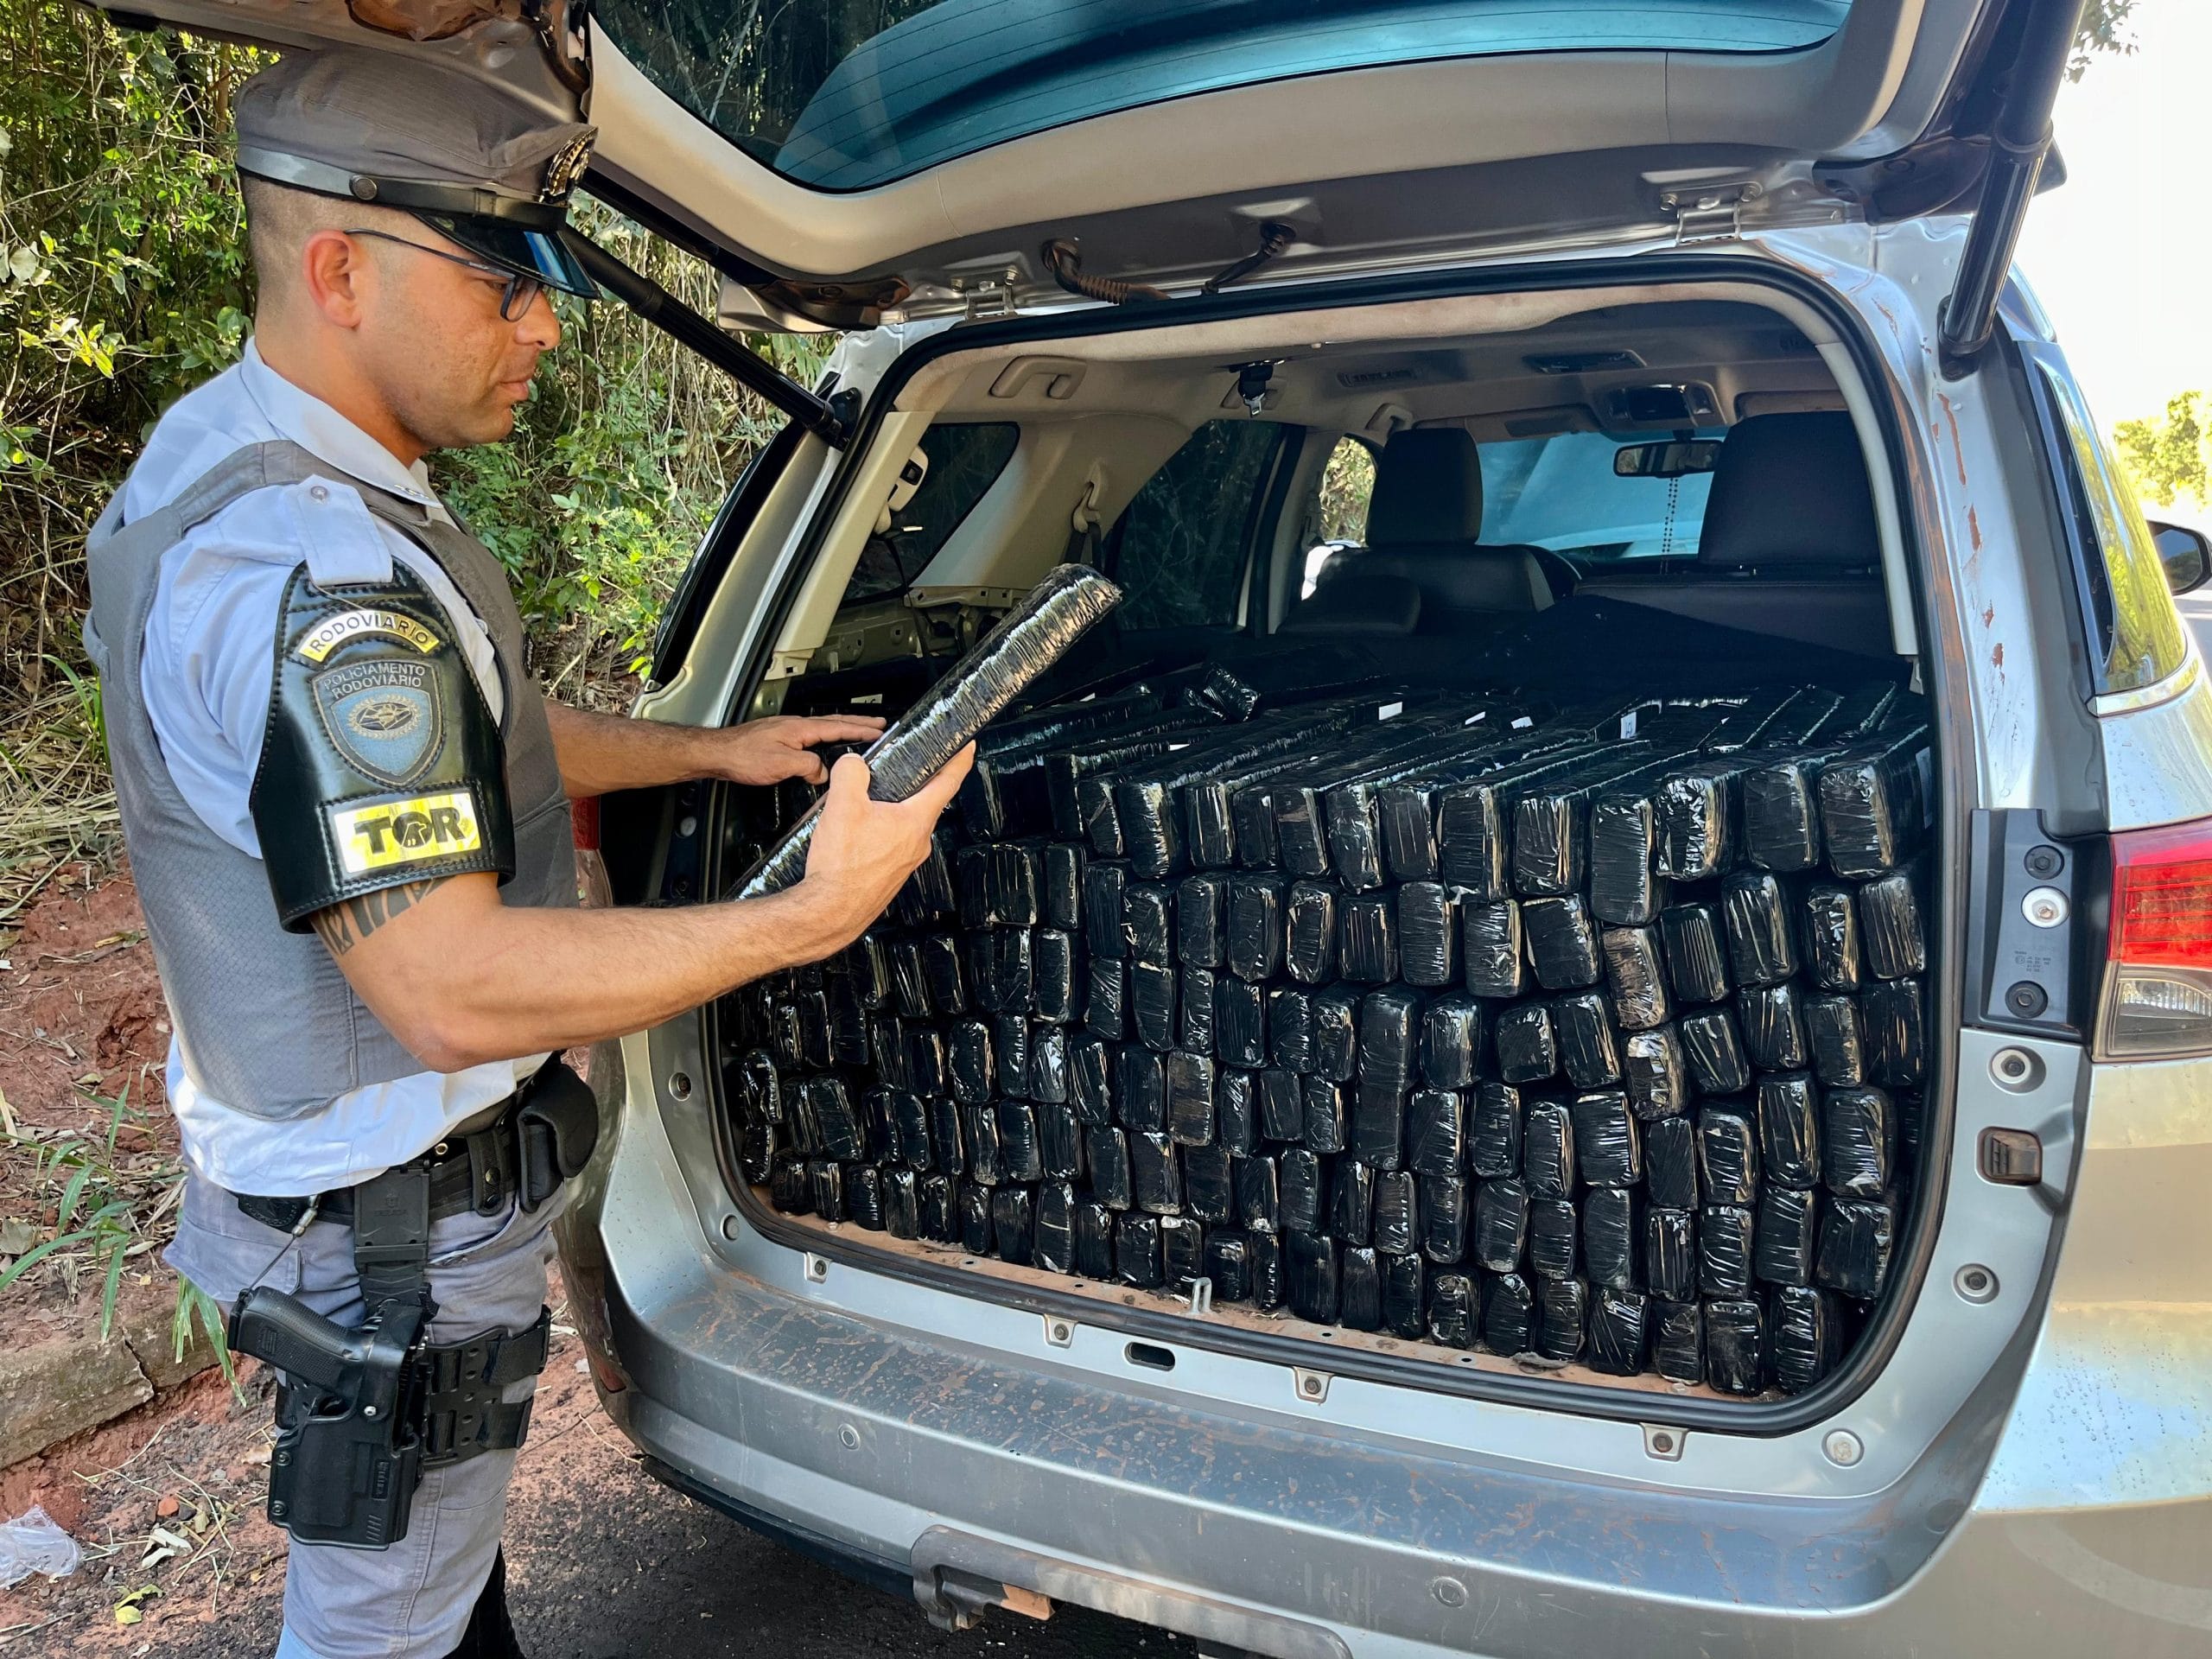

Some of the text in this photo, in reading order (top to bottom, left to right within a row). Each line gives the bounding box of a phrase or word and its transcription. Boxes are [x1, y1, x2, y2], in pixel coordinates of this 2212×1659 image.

[309, 613, 429, 653] RODOVIARIO
[324, 663, 425, 690] POLICIAMENTO
[332, 674, 422, 700] RODOVIARIO
[353, 806, 467, 855] TOR
